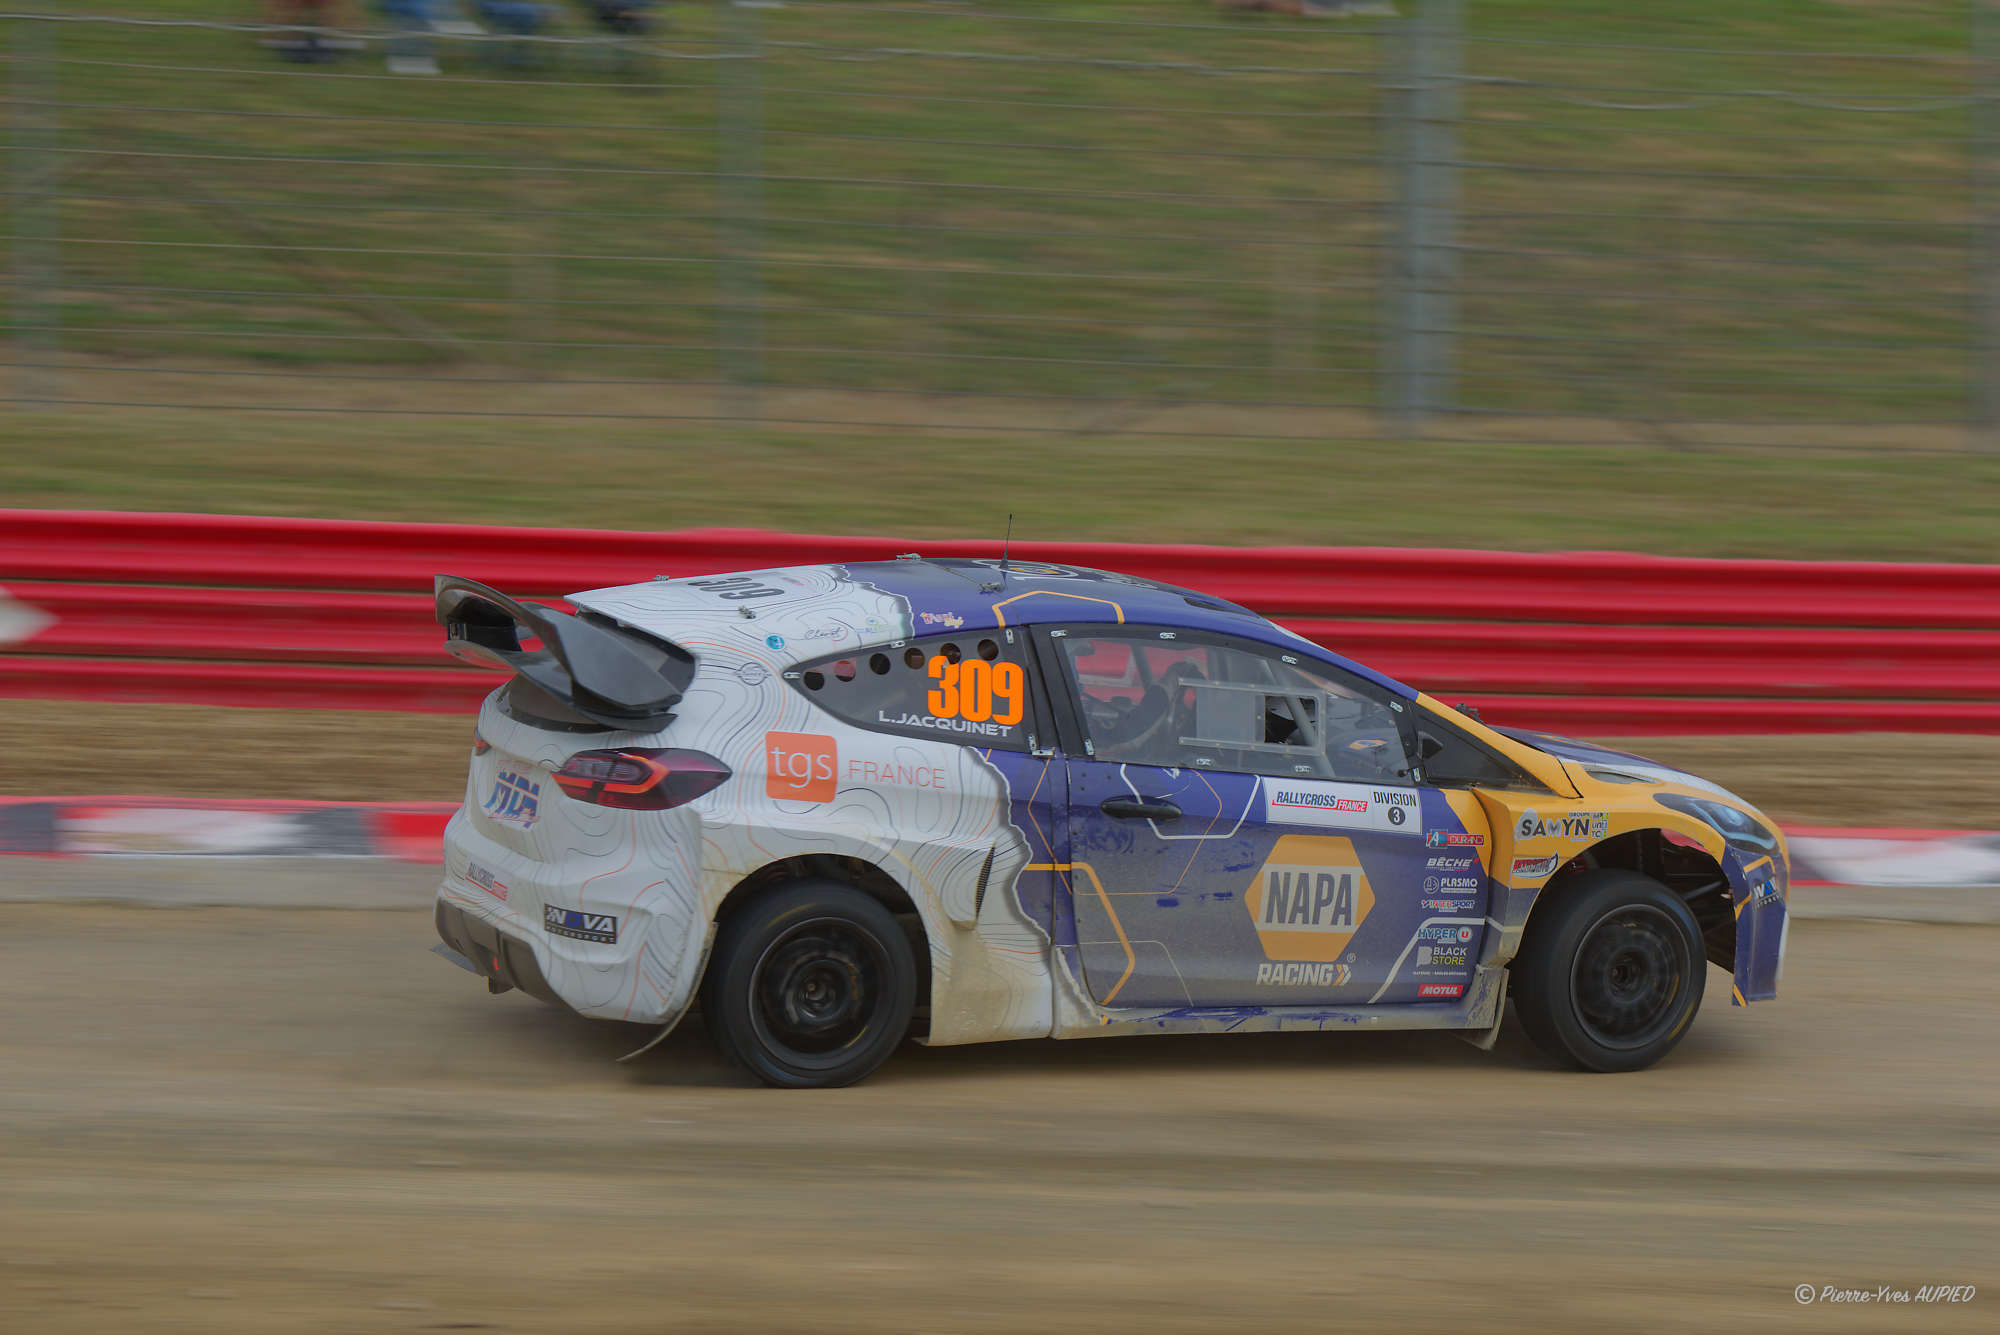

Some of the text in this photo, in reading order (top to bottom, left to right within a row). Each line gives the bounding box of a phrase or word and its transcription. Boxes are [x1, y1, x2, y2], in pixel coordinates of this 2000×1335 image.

[687, 577, 785, 600] 309
[927, 655, 1024, 726] 309
[878, 710, 1014, 737] L.JACQUINET
[769, 746, 947, 790] tgs FRANCE
[1275, 791, 1367, 813] RALLYCROSS FRANCE
[1373, 791, 1418, 807] DIVISION
[1392, 809, 1401, 826] 3
[1521, 818, 1590, 837] SAMYN
[1441, 877, 1478, 888] PLASMO
[1264, 871, 1353, 926] NAPA
[1418, 927, 1457, 940] HYPER
[1432, 955, 1465, 966] STORE
[1433, 946, 1468, 956] BLACK
[1256, 962, 1334, 986] RACING
[1422, 986, 1459, 995] MOTUL
